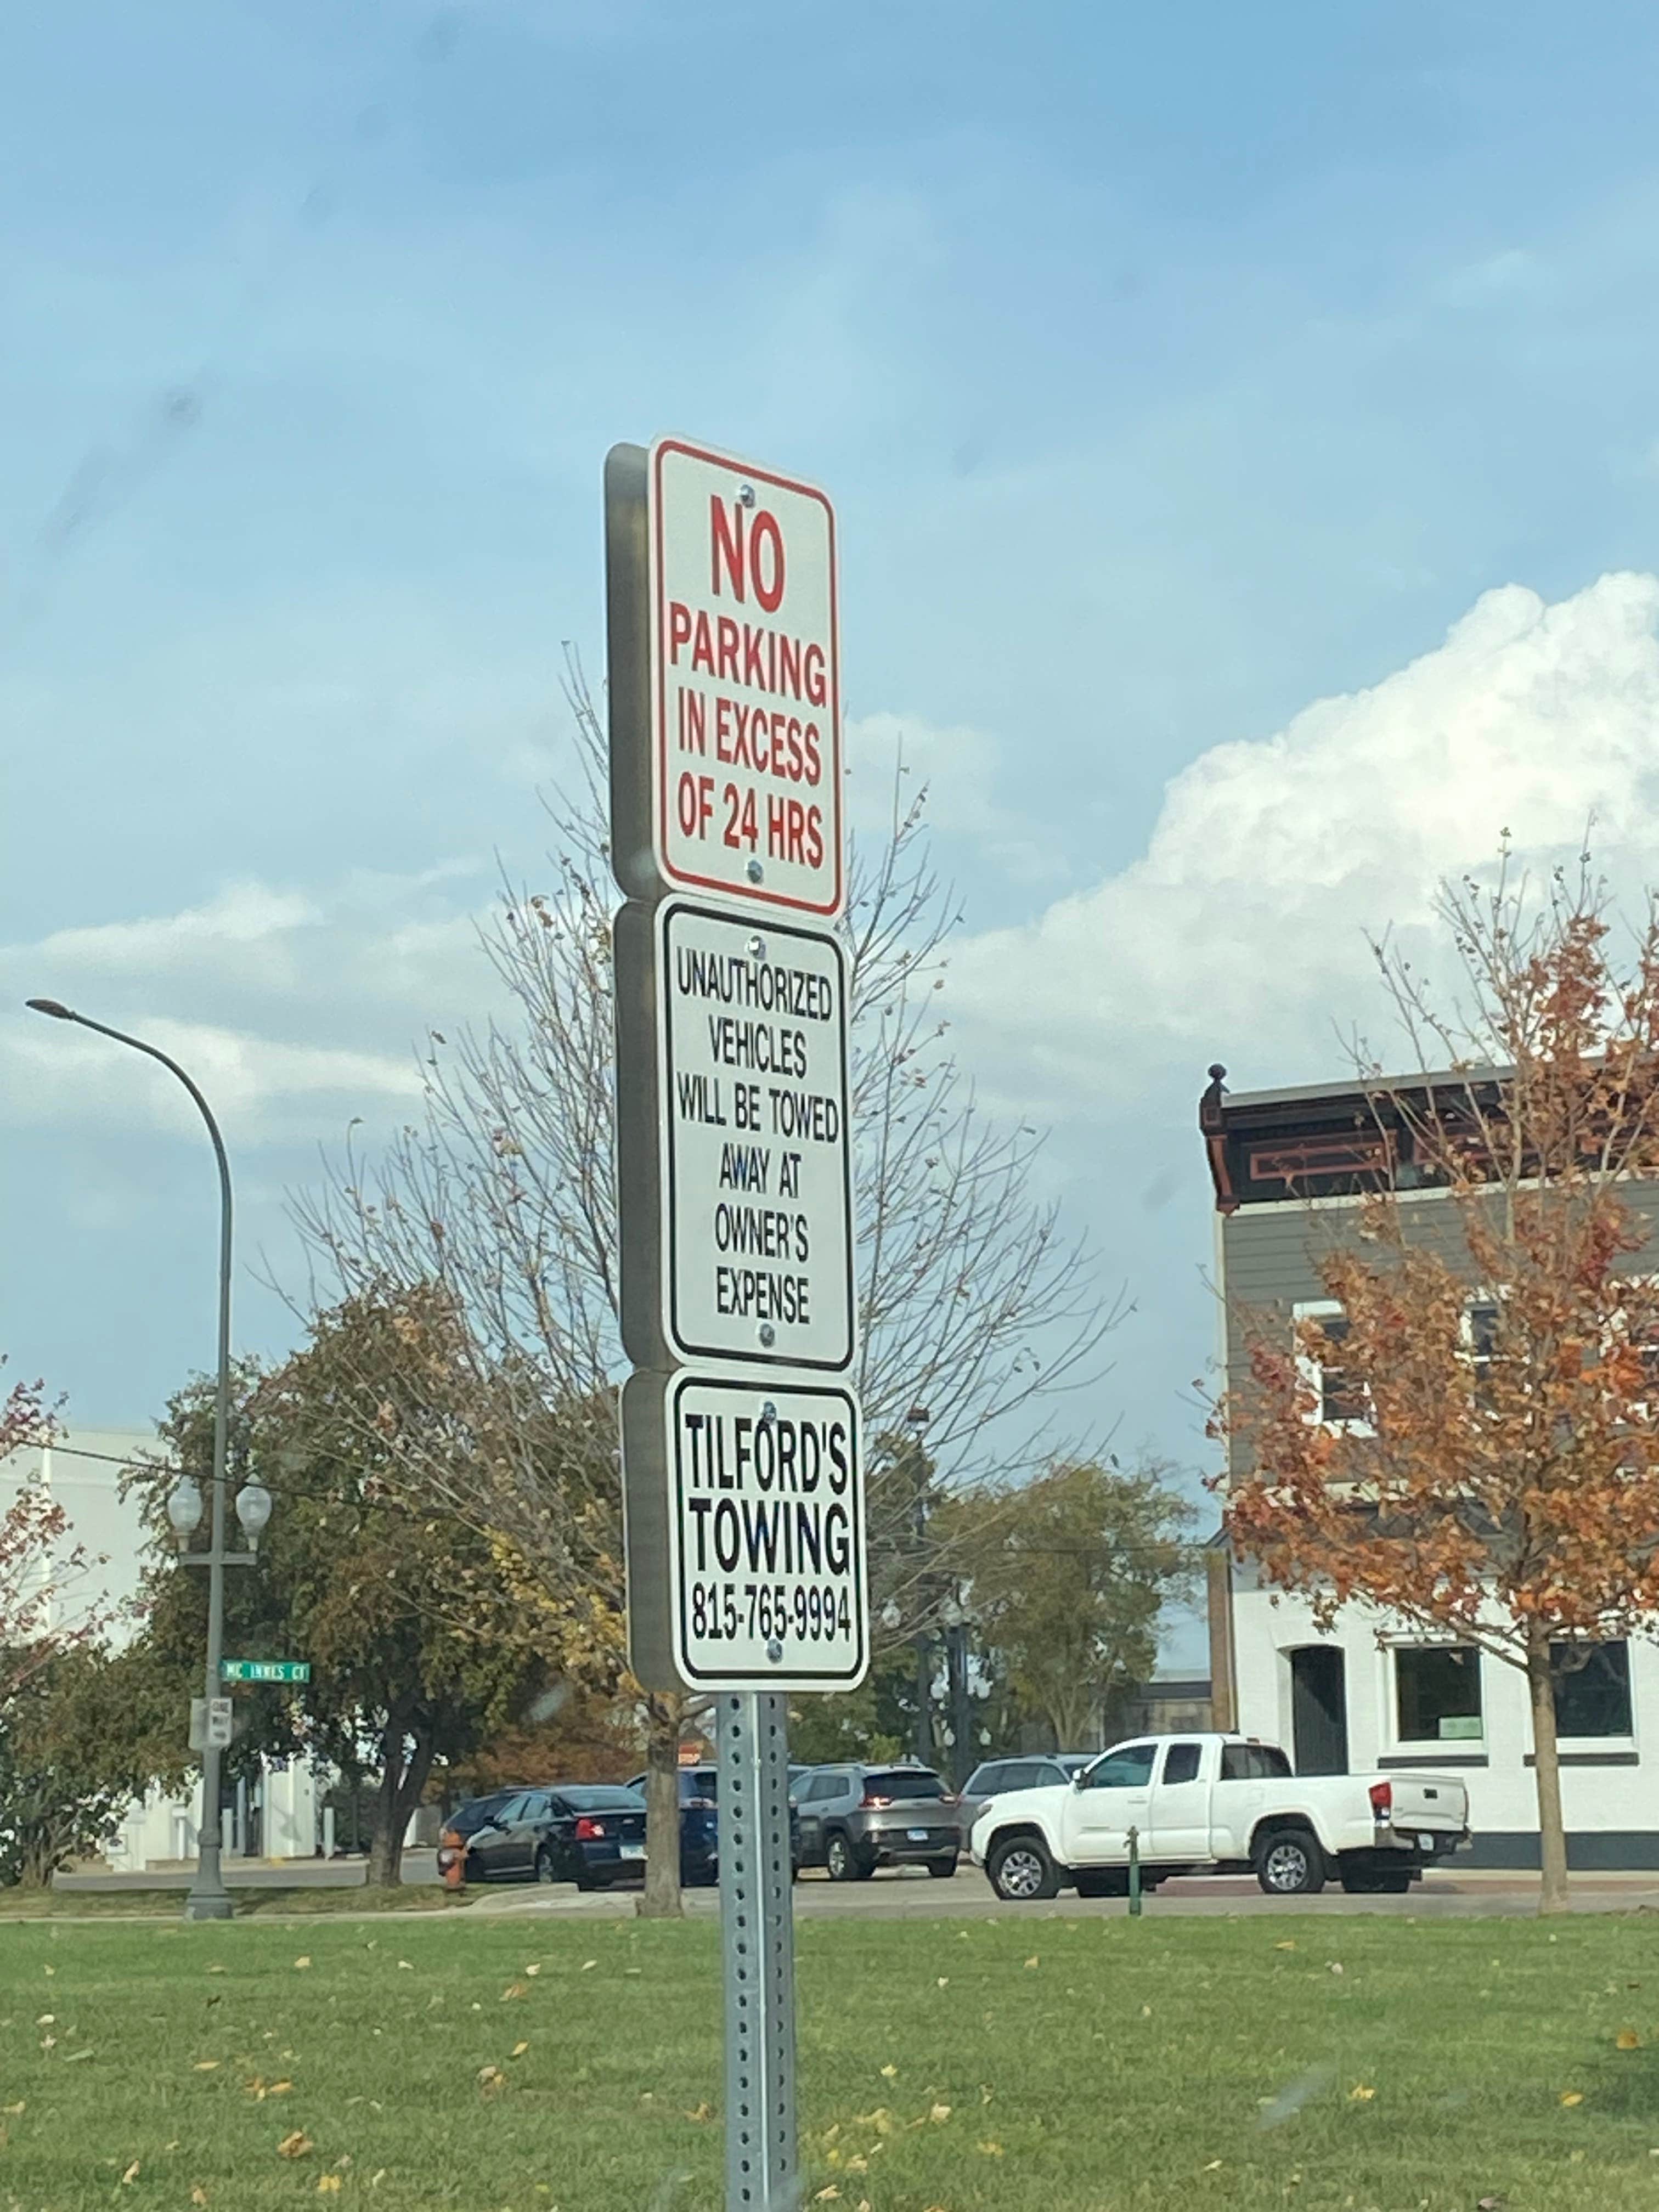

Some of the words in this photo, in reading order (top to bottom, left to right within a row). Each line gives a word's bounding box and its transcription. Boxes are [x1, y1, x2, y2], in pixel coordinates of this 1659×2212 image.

[711, 495, 785, 612] NO
[670, 601, 826, 707] PARKING
[678, 687, 706, 756] IN
[716, 697, 821, 787] EXCESS
[678, 772, 714, 841] OF
[724, 783, 758, 853] 24
[768, 794, 823, 870] HRS
[677, 946, 832, 1021] UNAUTHORIZED
[708, 1014, 807, 1079] VEHICLES
[678, 1072, 725, 1125] WILL
[735, 1083, 761, 1131] BE
[769, 1089, 839, 1143] TOWED
[719, 1143, 770, 1195] AWAY
[778, 1153, 802, 1198] AT
[715, 1203, 809, 1262] OWNER'S
[716, 1267, 810, 1324] EXPENSE
[685, 1414, 848, 1495] TILFORD'S
[689, 1497, 850, 1577] TOWING
[692, 1582, 851, 1642] 815-765-9994
